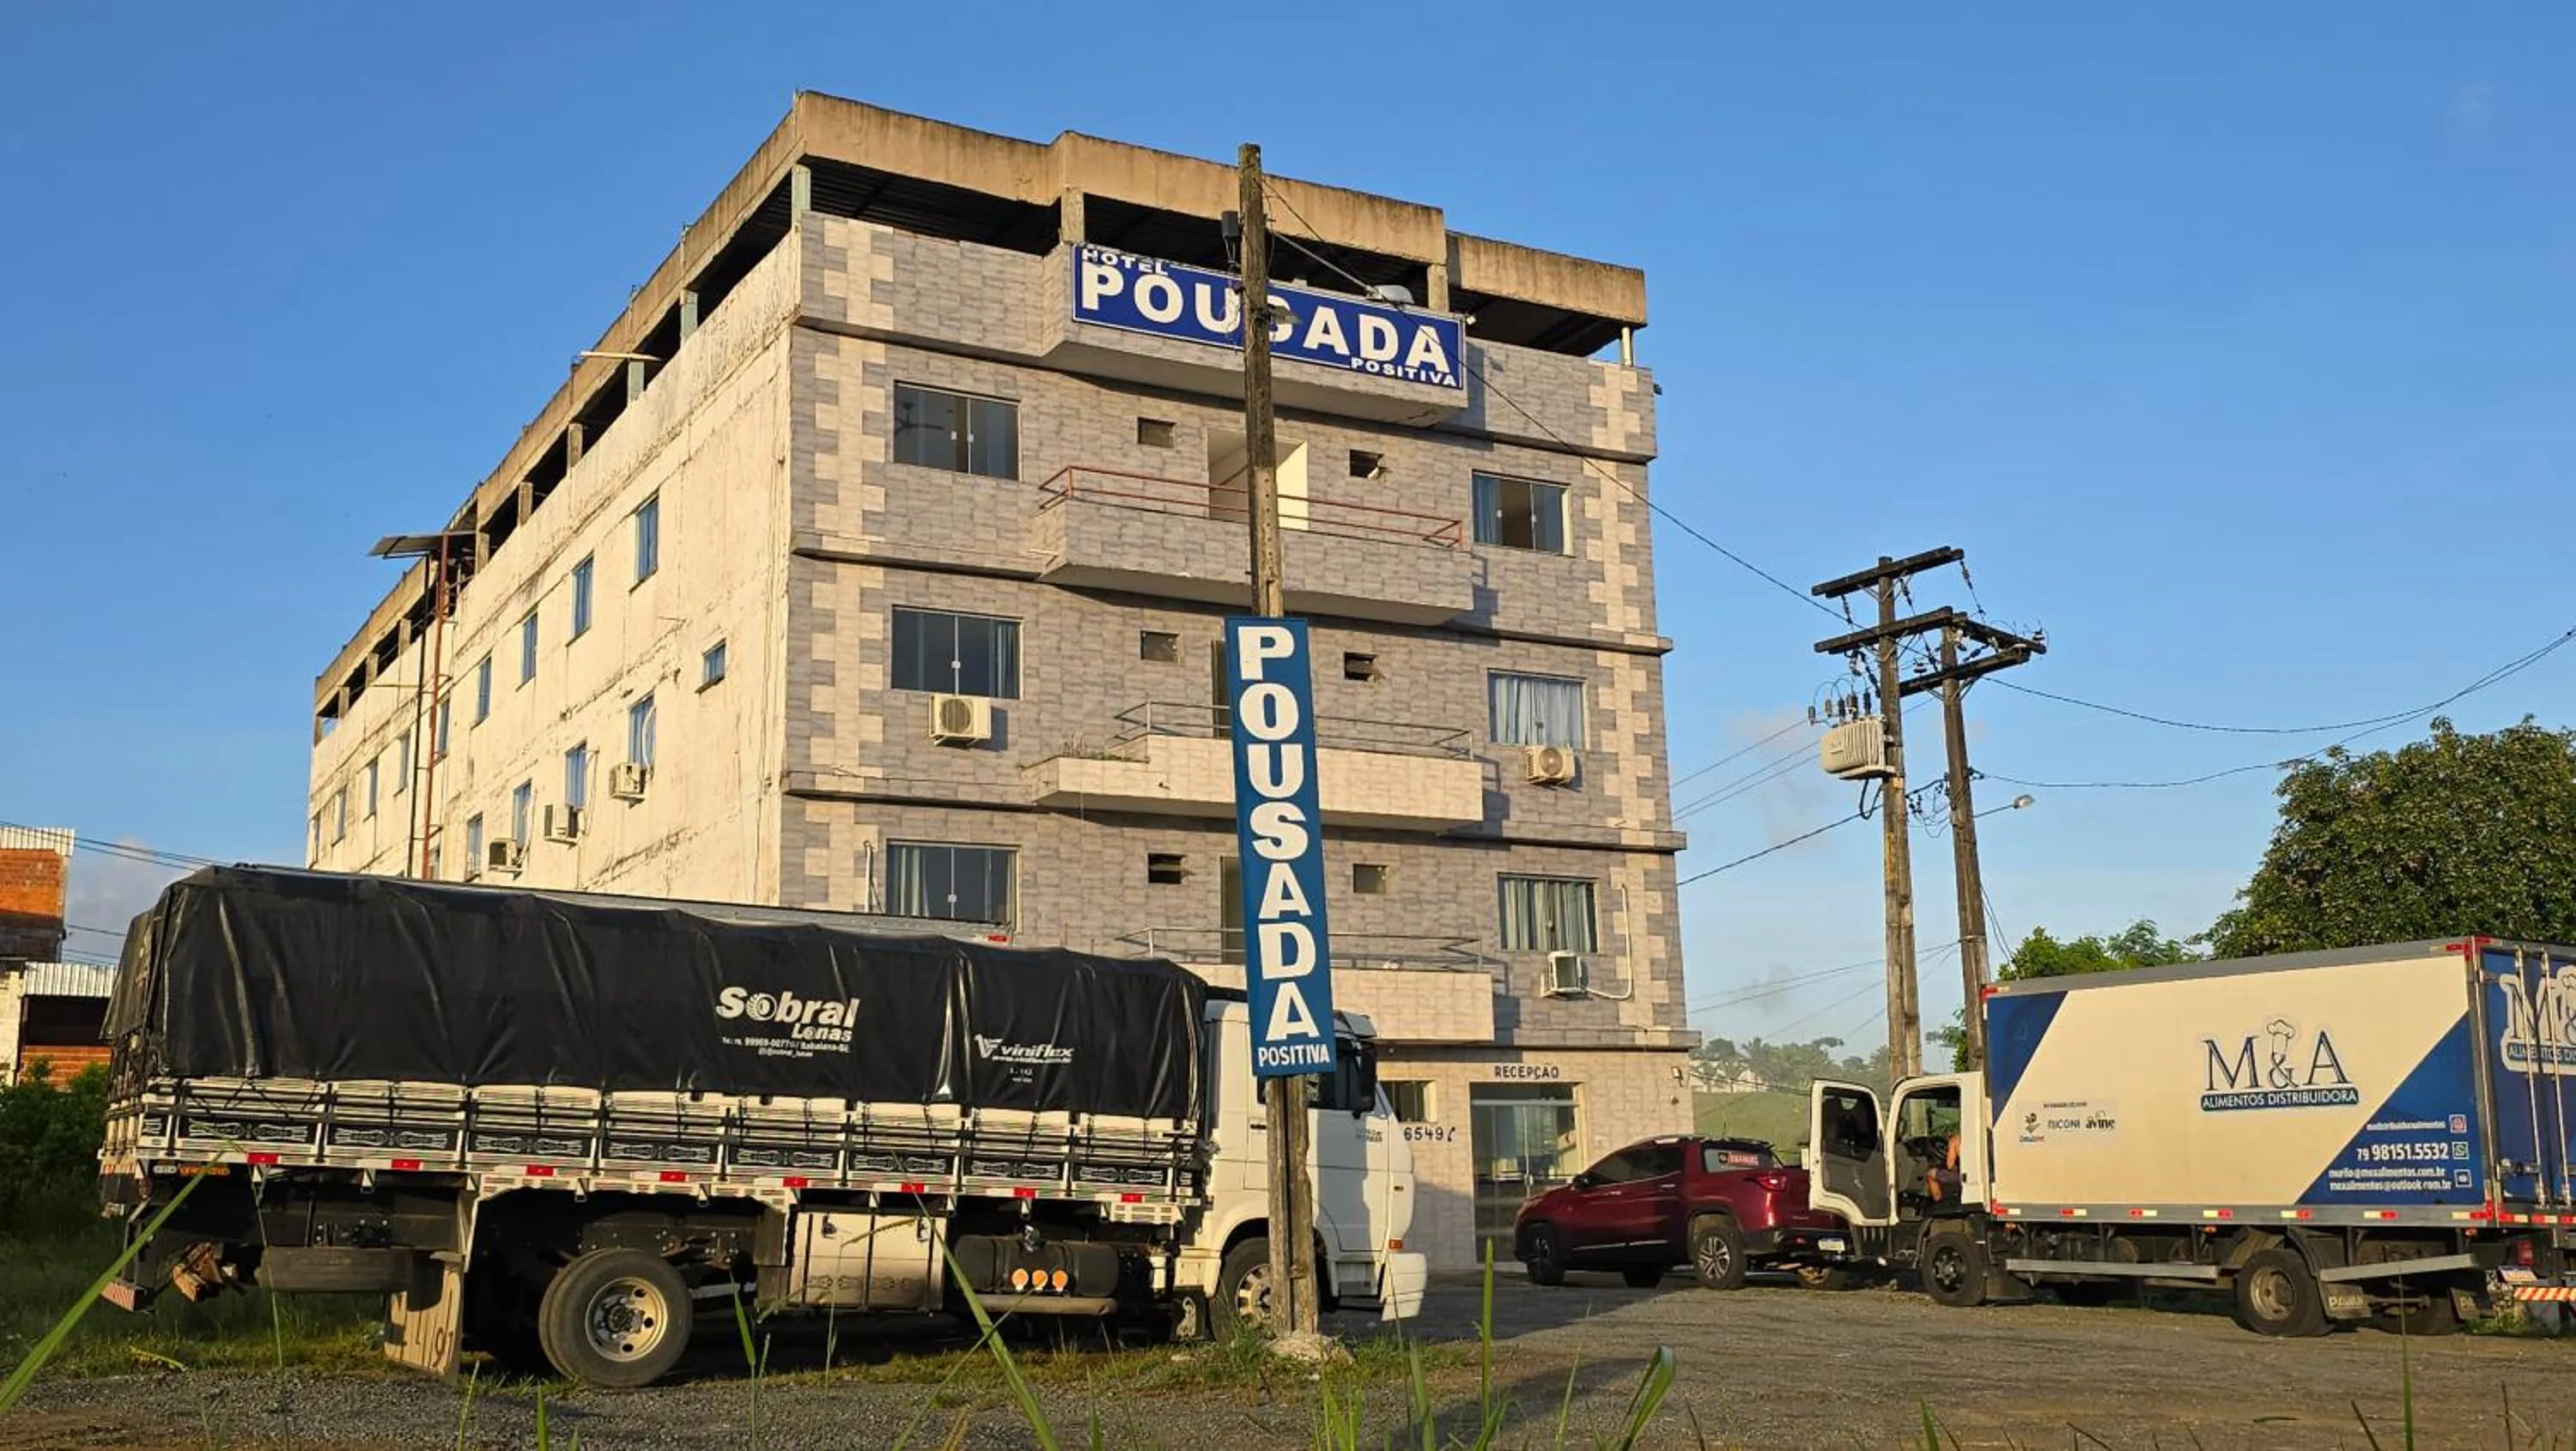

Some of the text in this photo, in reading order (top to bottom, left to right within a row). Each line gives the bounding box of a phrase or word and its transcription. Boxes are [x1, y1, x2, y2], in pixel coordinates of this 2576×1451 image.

[1081, 246, 1169, 276] HOTEL
[1351, 355, 1457, 388] POSITIVA
[1237, 626, 1321, 1041] POUSADA
[715, 987, 860, 1028] Sobral
[1258, 1043, 1330, 1067] POSITIVA
[2202, 1090, 2358, 1109] ALIMENTOS DISTRIBUIDORA
[1403, 1126, 1444, 1141] 6549
[2357, 1142, 2449, 1161] 79 98151.5532
